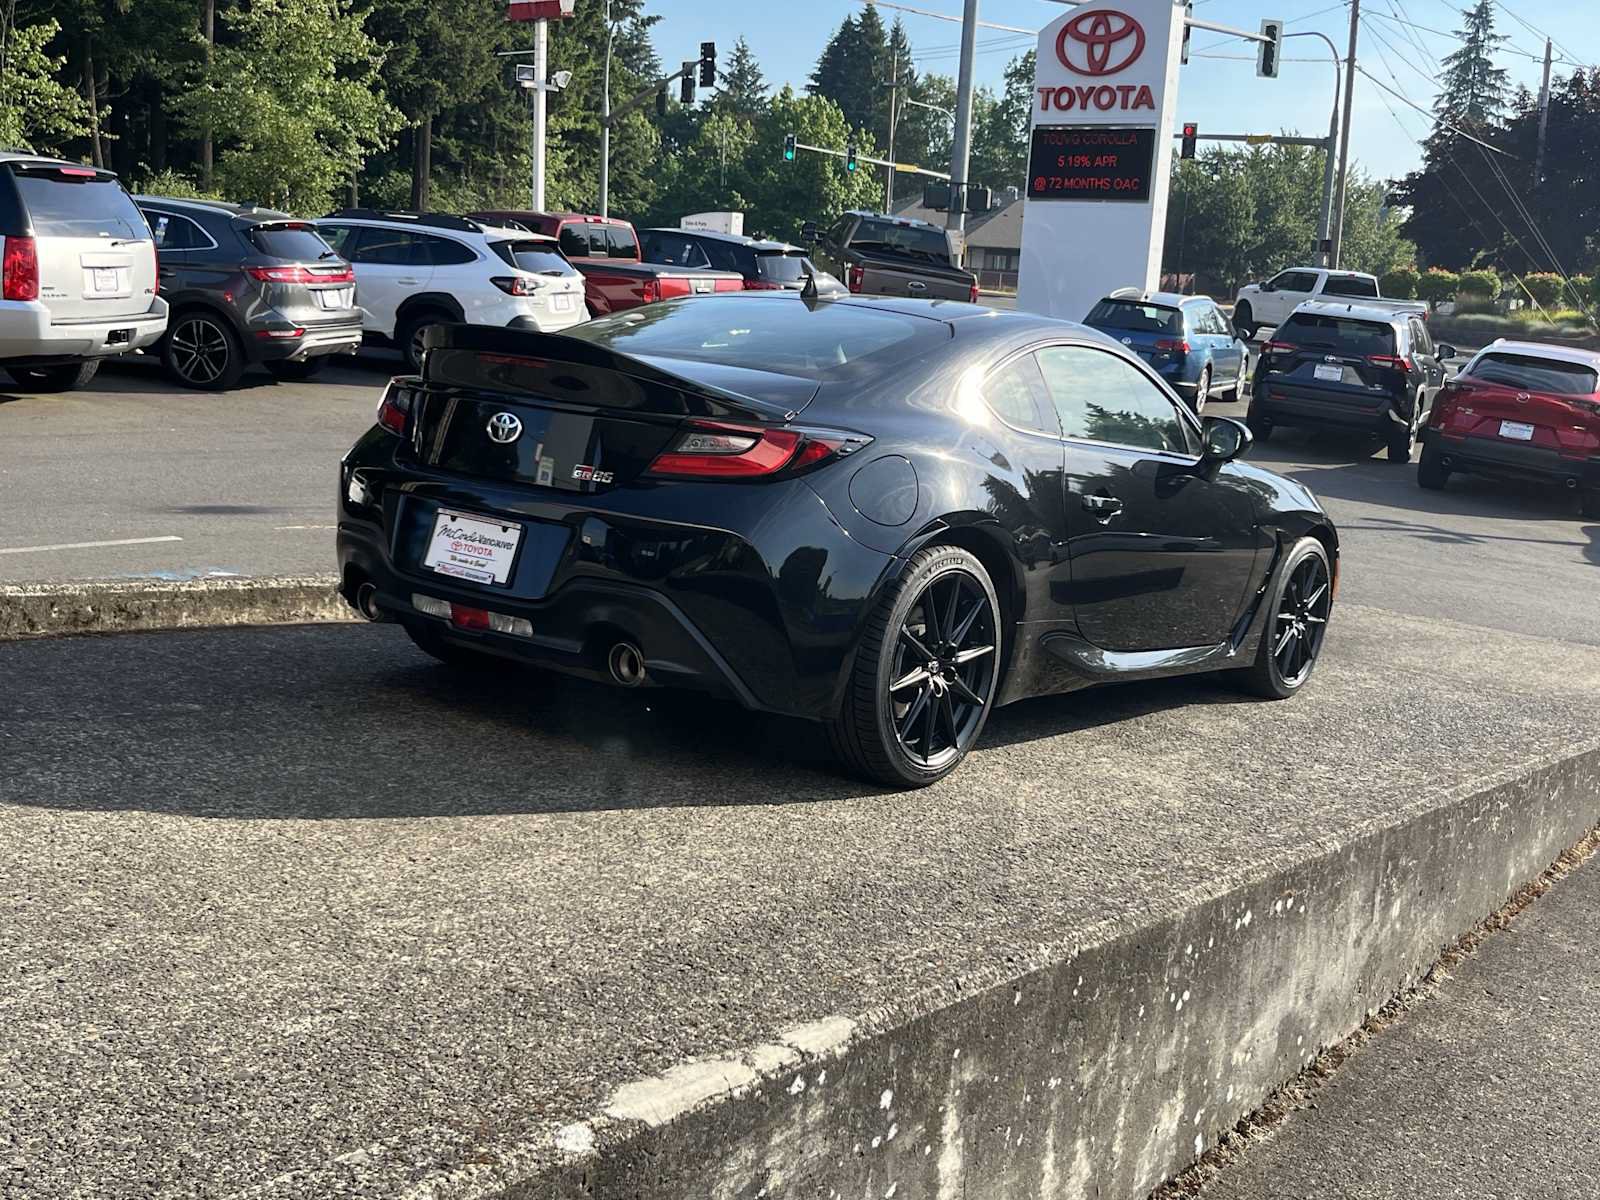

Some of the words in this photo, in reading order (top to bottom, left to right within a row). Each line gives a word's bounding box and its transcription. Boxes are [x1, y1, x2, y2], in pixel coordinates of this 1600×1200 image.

[1037, 85, 1155, 111] TOYOTA
[1094, 154, 1119, 167] APR
[1034, 176, 1047, 192] @
[1049, 177, 1062, 189] 72
[1064, 177, 1111, 190] MONTHS
[1113, 178, 1140, 190] OAC
[463, 543, 493, 557] TOYOTA
